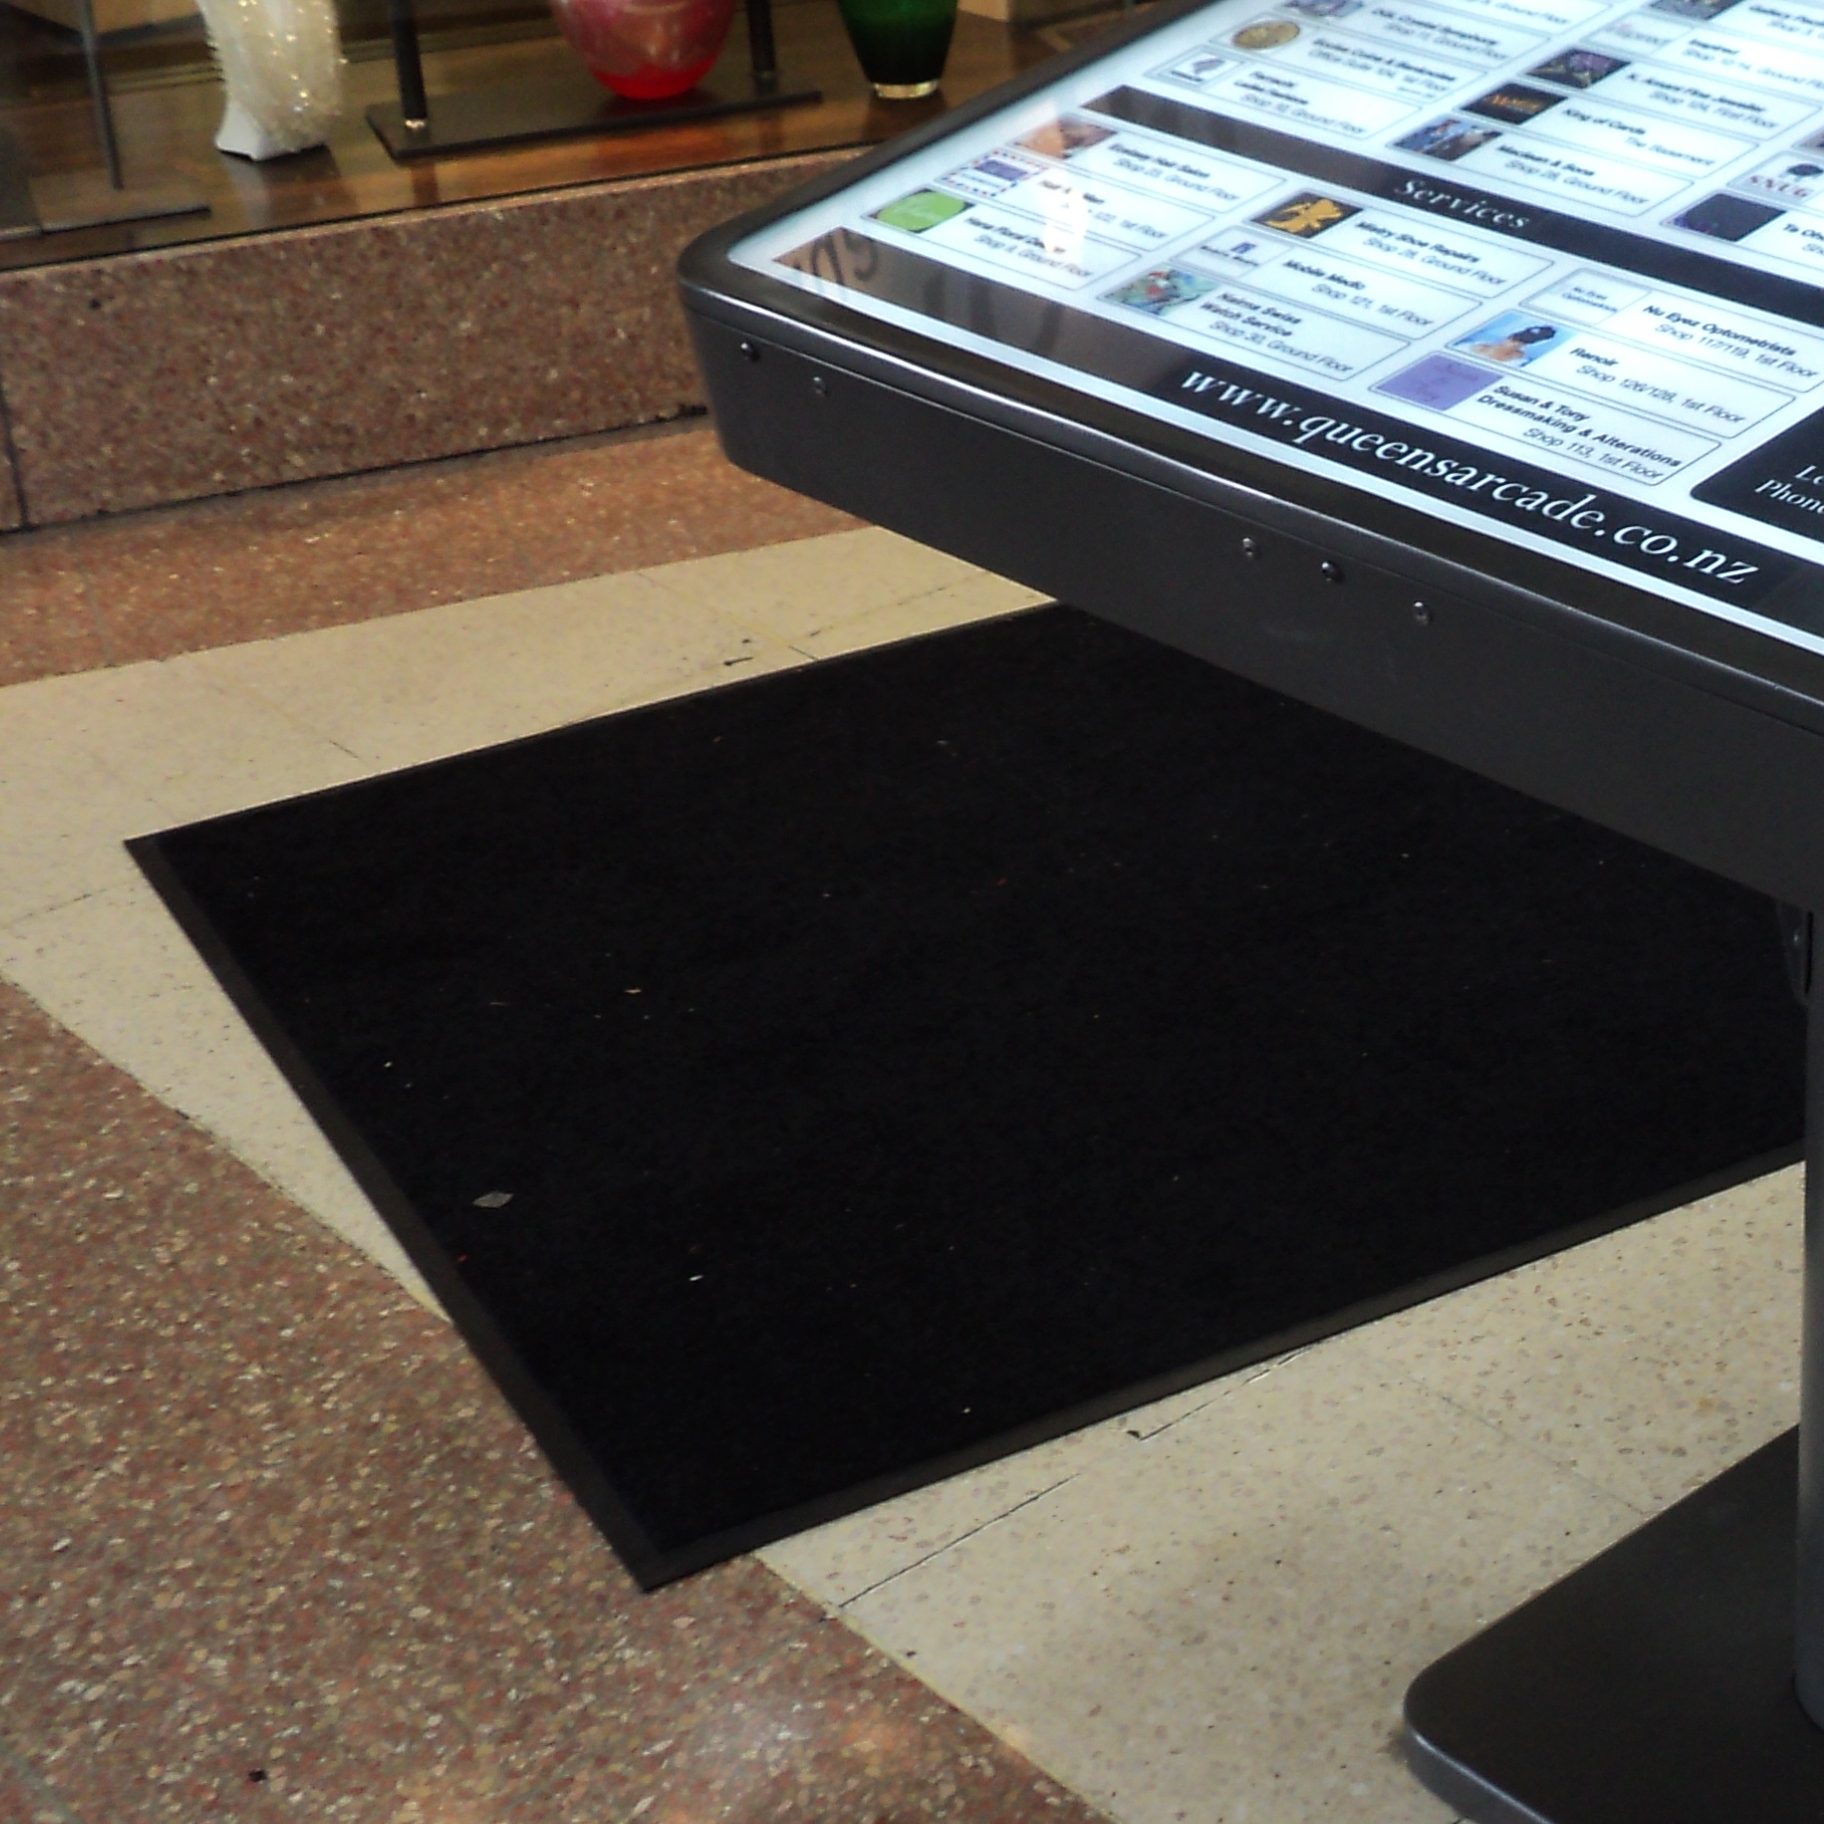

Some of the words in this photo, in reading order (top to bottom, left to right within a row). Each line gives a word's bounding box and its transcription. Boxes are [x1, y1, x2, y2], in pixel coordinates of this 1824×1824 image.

[1113, 158, 1146, 172] Shop
[1164, 175, 1210, 192] Ground
[1207, 188, 1241, 201] Floor
[1394, 180, 1531, 227] Services
[1283, 260, 1326, 277] Mobile
[1395, 234, 1430, 247] Shoe
[1429, 244, 1481, 263] Repairs
[1199, 303, 1243, 320] Watch
[1241, 316, 1293, 337] Service
[1311, 284, 1348, 299] Shop
[1377, 305, 1400, 316] 1st
[1396, 310, 1434, 326] Floor
[1209, 321, 1247, 337] Shop
[1266, 340, 1320, 362] Ground
[1315, 356, 1354, 373] Floor
[1642, 305, 1666, 316] Nu
[1665, 312, 1701, 327] Eyez
[1701, 324, 1797, 356] Optometrists
[1654, 324, 1695, 340] Shop
[1754, 354, 1779, 366] 1st
[1776, 361, 1819, 378] Floor
[1569, 348, 1619, 366] Renoir
[1492, 386, 1540, 405] Susan
[1554, 405, 1591, 422] Tony
[1575, 365, 1617, 382] Shop
[1681, 398, 1706, 411] 1st
[1703, 405, 1746, 423] Floor
[1476, 395, 1579, 433] Dressmaking
[1591, 434, 1683, 467] Alterations
[1522, 428, 1565, 446] Shop
[1566, 442, 1596, 458] 113,
[1598, 453, 1624, 466] 1st
[1620, 461, 1664, 479] Floor
[1178, 370, 1762, 584] www.queensarcade.co.nz
